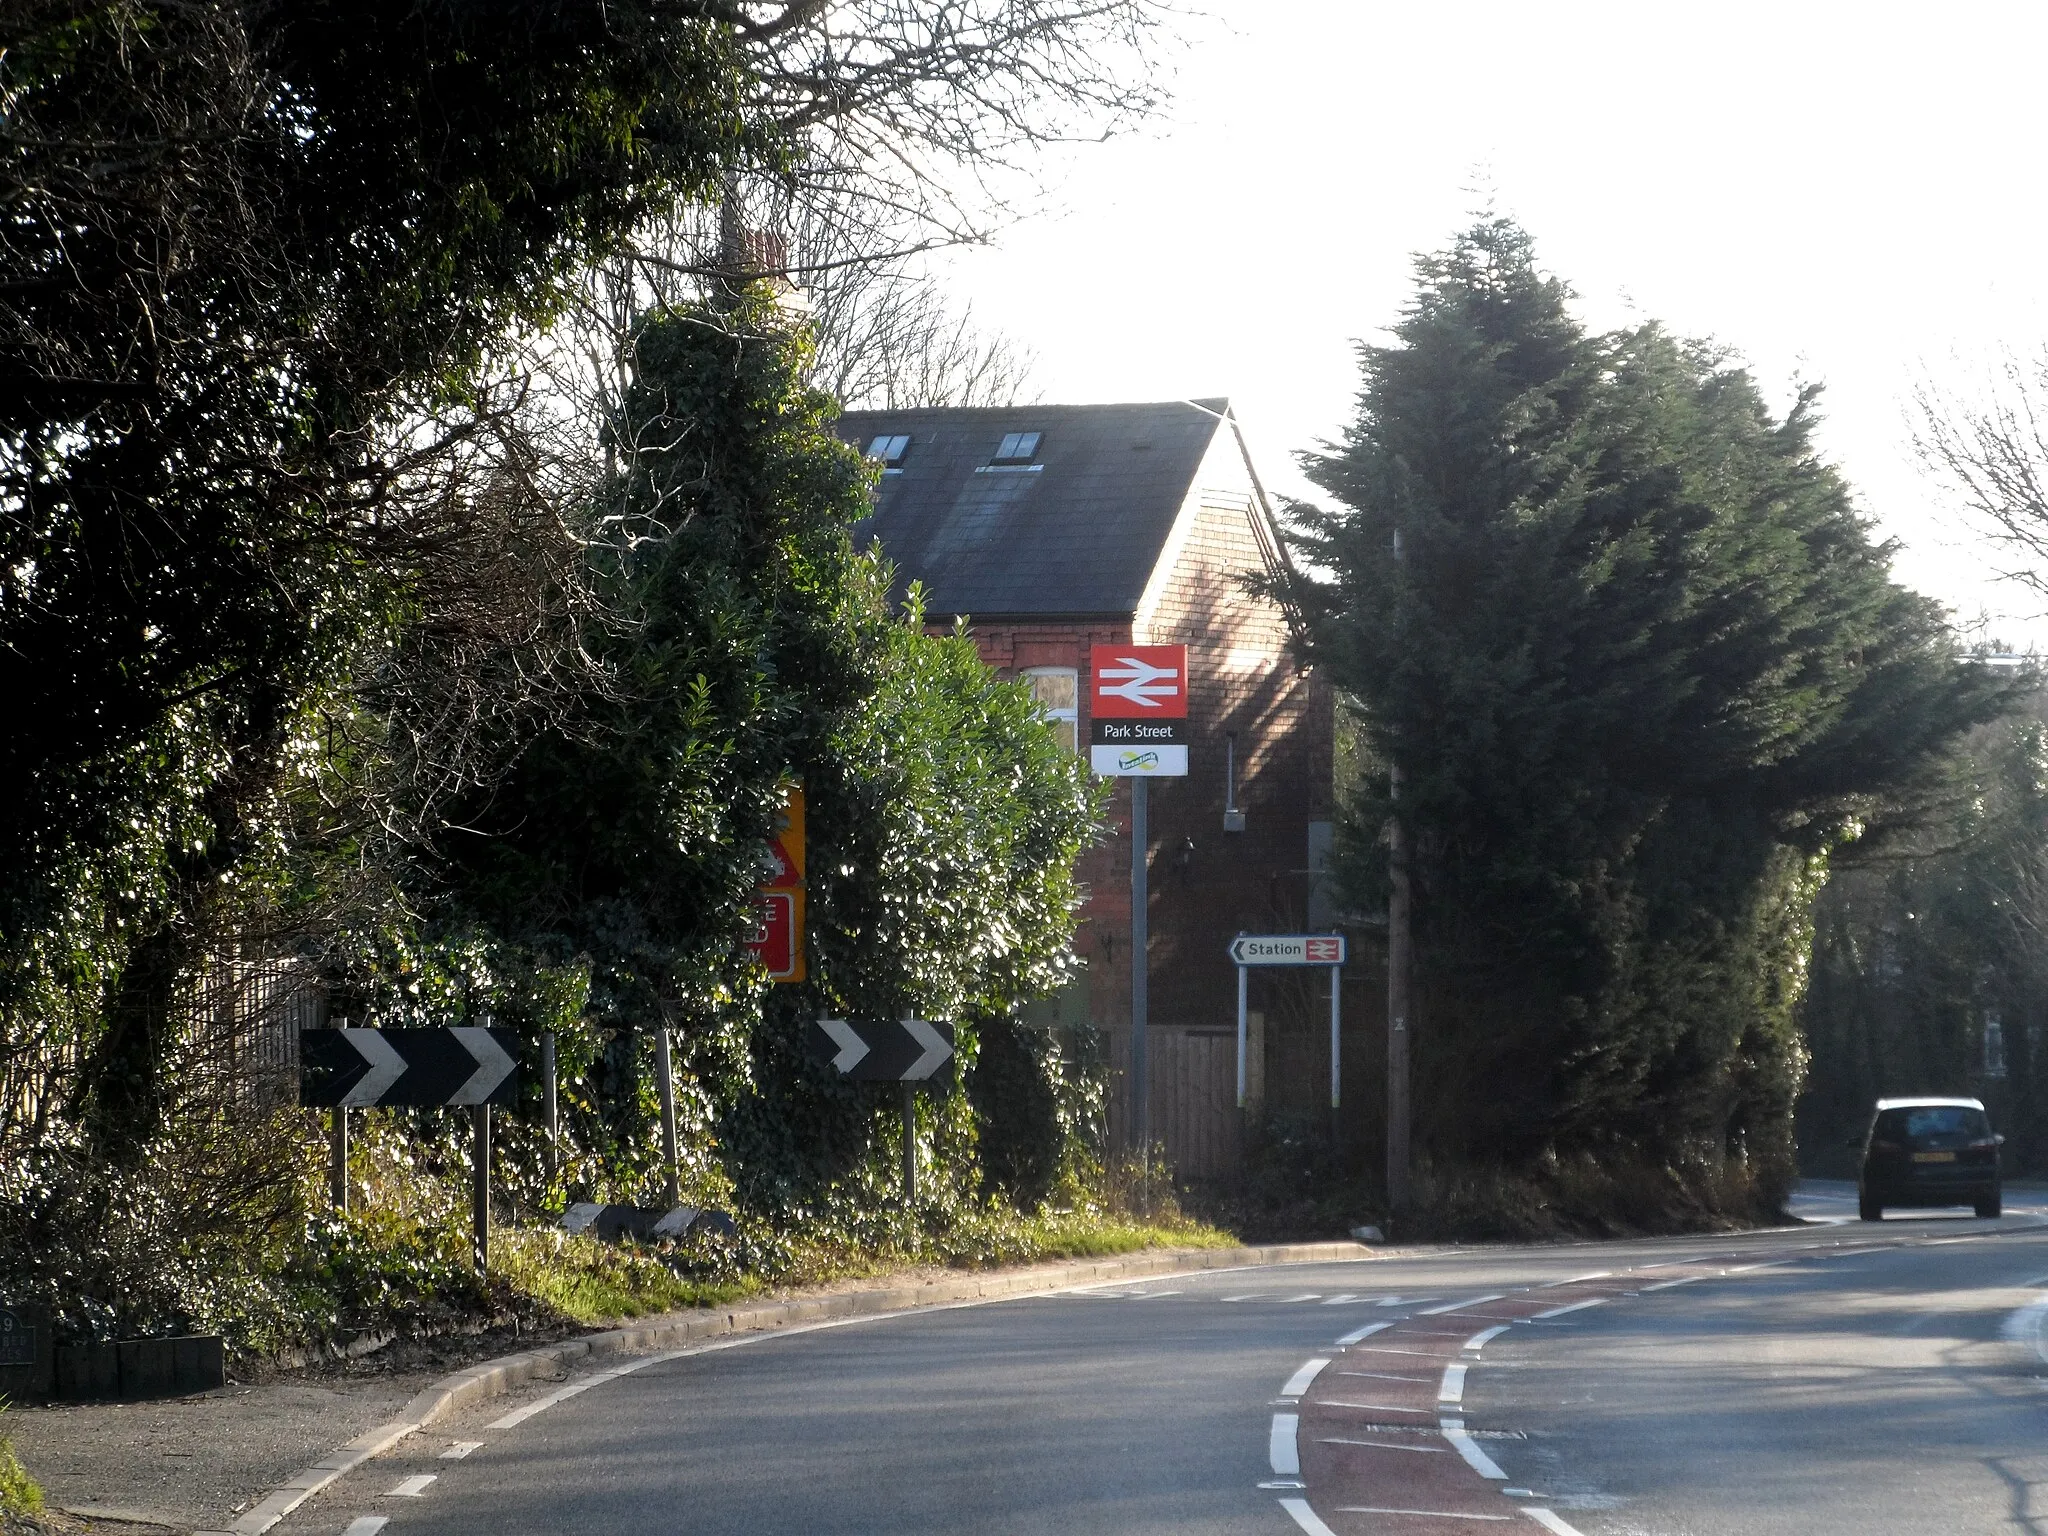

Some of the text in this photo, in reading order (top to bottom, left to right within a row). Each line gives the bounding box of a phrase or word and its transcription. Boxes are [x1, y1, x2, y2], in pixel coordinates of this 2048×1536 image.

[1104, 724, 1174, 738] Park Street
[1248, 943, 1301, 956] Station
